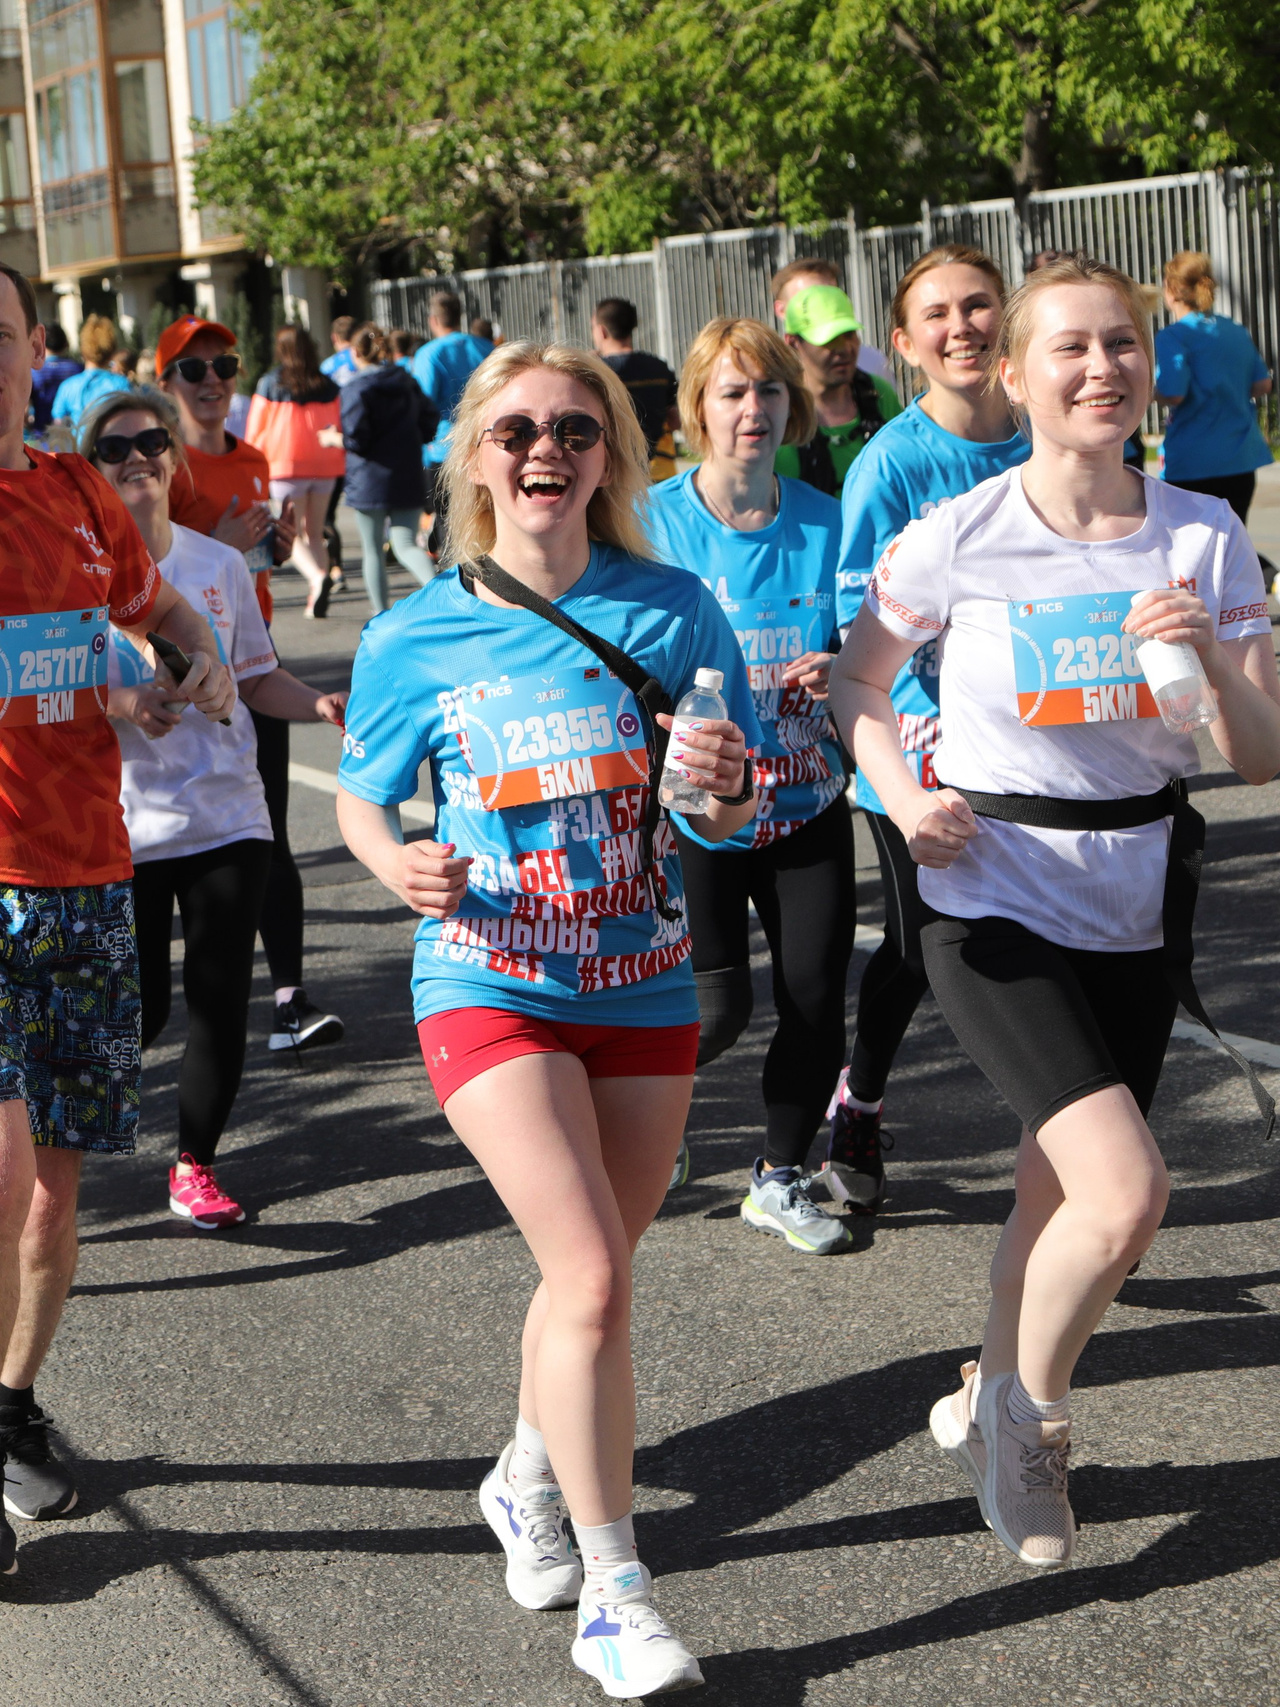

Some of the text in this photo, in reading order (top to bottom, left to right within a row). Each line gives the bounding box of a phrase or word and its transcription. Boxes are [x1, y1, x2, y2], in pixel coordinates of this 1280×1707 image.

[1036, 601, 1064, 614] ПСБ
[7, 618, 28, 629] ПСБ
[19, 645, 90, 690] 25717
[1052, 634, 1144, 683] 2326
[487, 684, 513, 700] ПСБ
[502, 704, 614, 765] 23355
[467, 847, 574, 897] #ЗАБЕГ
[614, 1570, 640, 1583] Reebok
